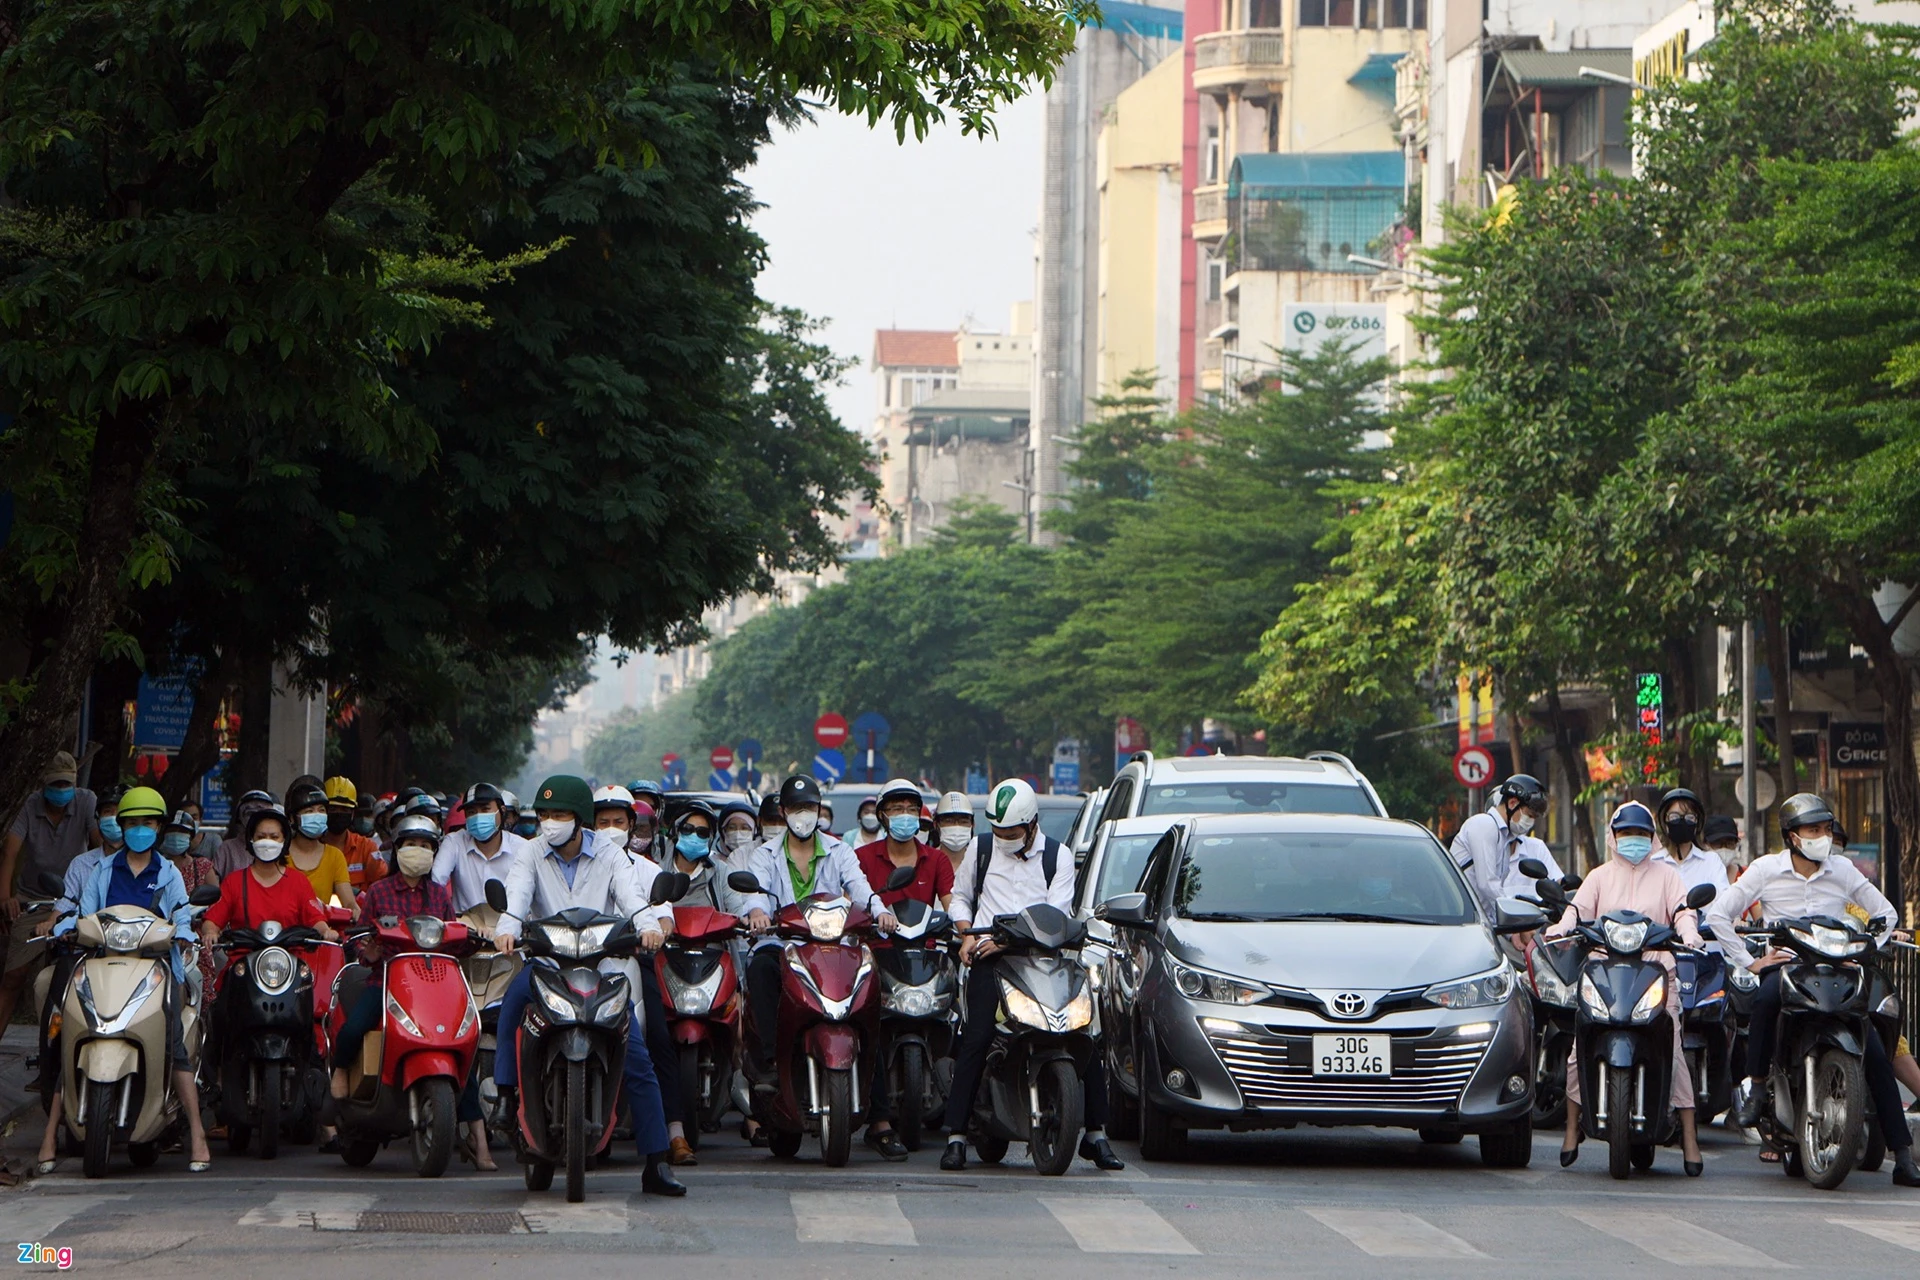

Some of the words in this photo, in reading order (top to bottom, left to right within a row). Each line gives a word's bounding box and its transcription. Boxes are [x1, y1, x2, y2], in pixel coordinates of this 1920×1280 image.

[1837, 746, 1887, 763] GENCE
[1335, 1037, 1368, 1054] 30G
[1322, 1056, 1382, 1073] 933.46
